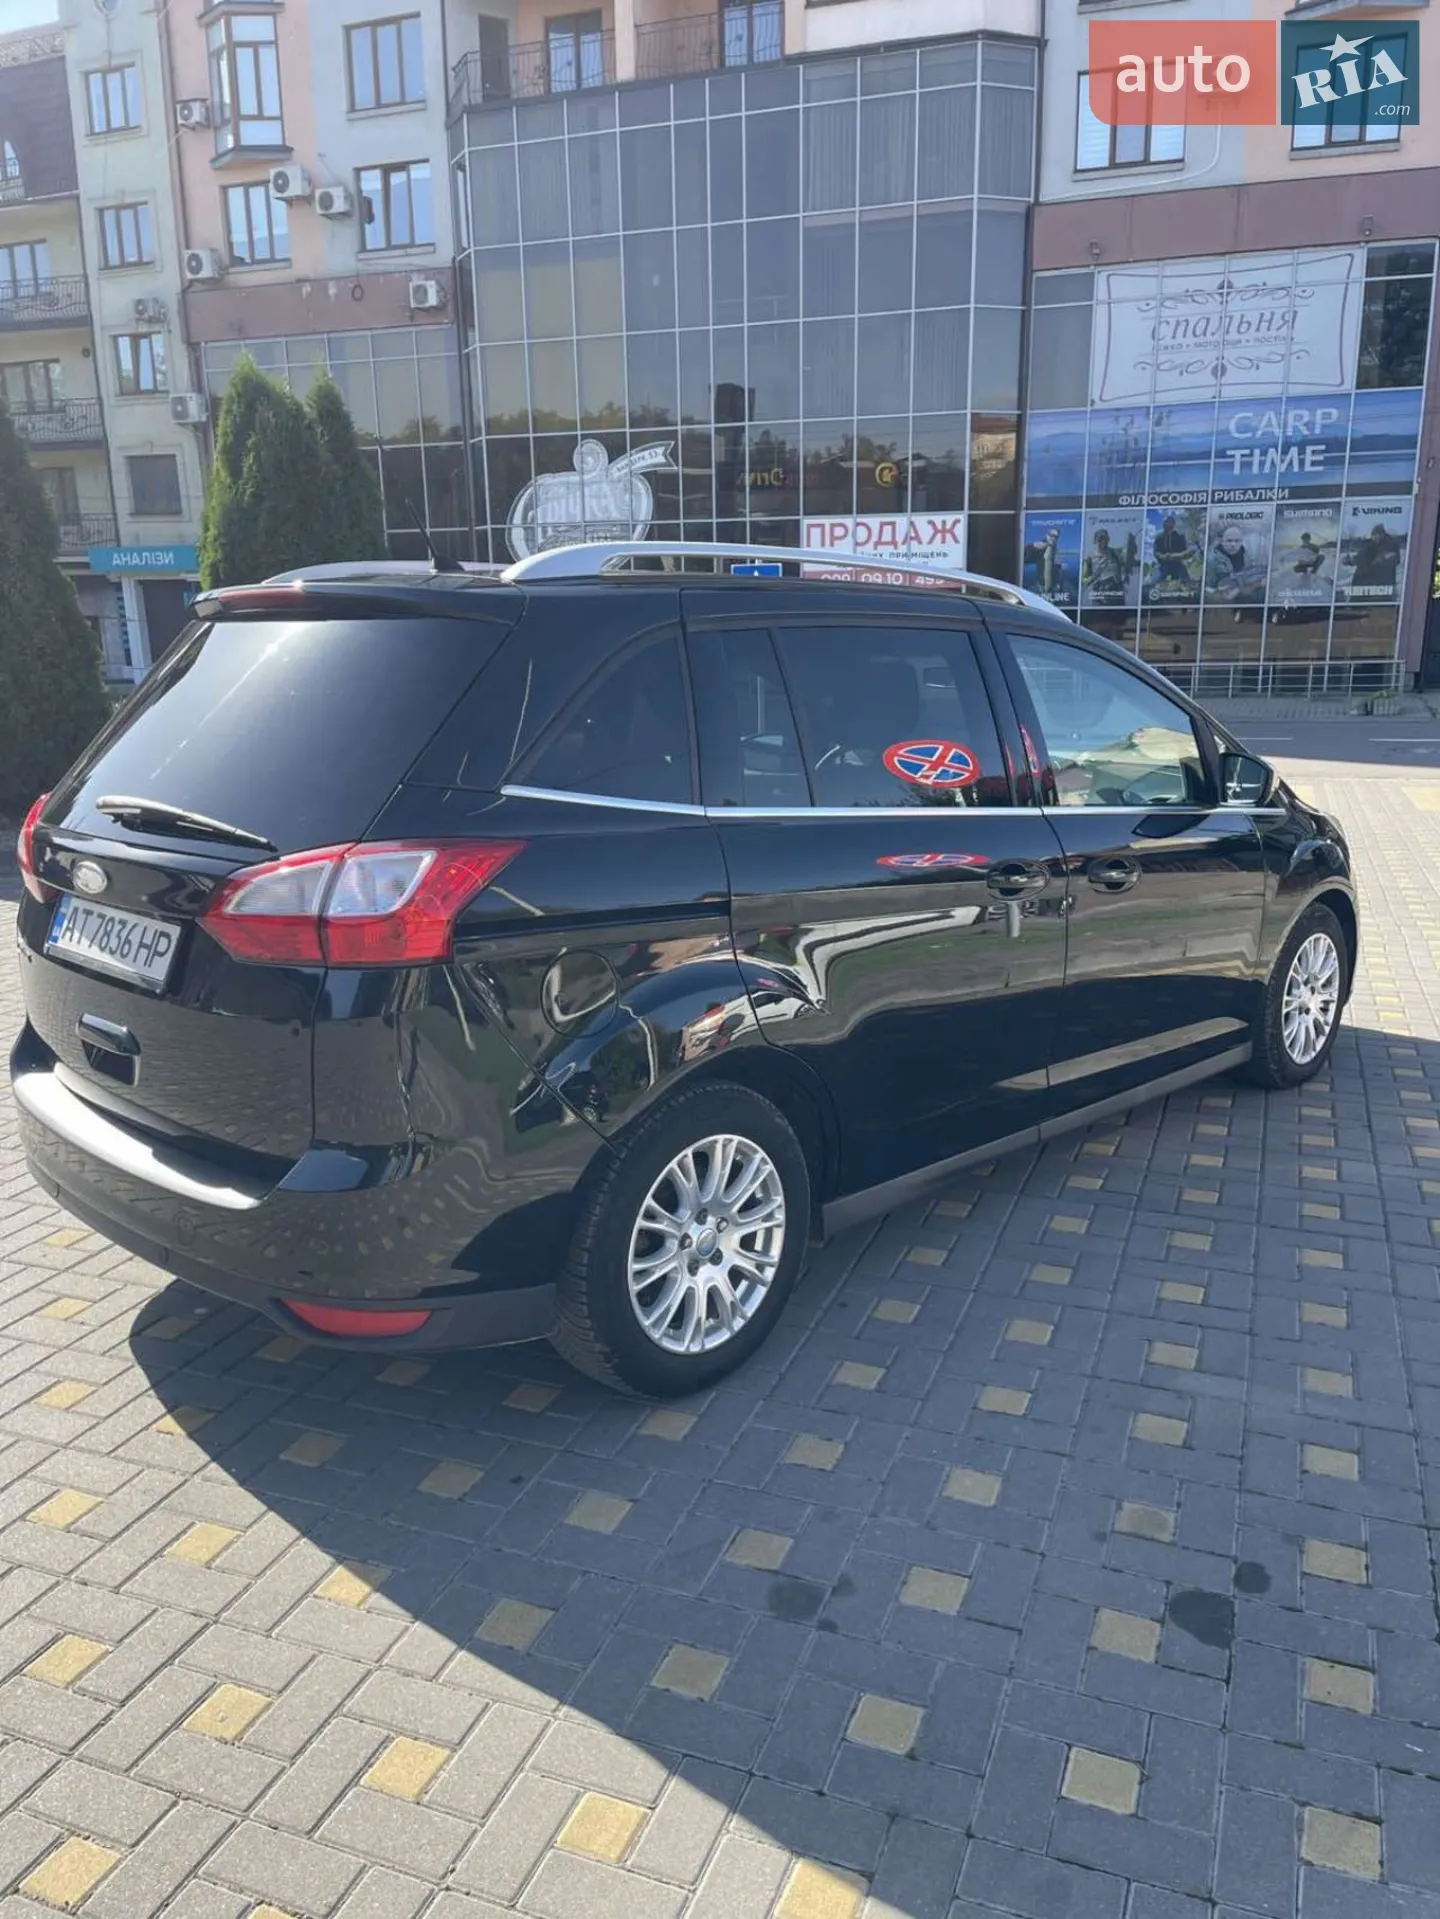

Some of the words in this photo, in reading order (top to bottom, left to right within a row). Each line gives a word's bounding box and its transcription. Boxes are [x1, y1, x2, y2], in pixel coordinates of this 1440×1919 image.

[1151, 310, 1298, 342] спальня
[1228, 408, 1339, 440] CARP
[1225, 444, 1326, 475] TIME
[1118, 491, 1207, 506] ФІЛОСОФІЯ
[1214, 488, 1289, 503] РИБАЛКИ
[805, 518, 961, 551] ПРОДАЖ
[112, 551, 174, 567] АНАЛІЗИ
